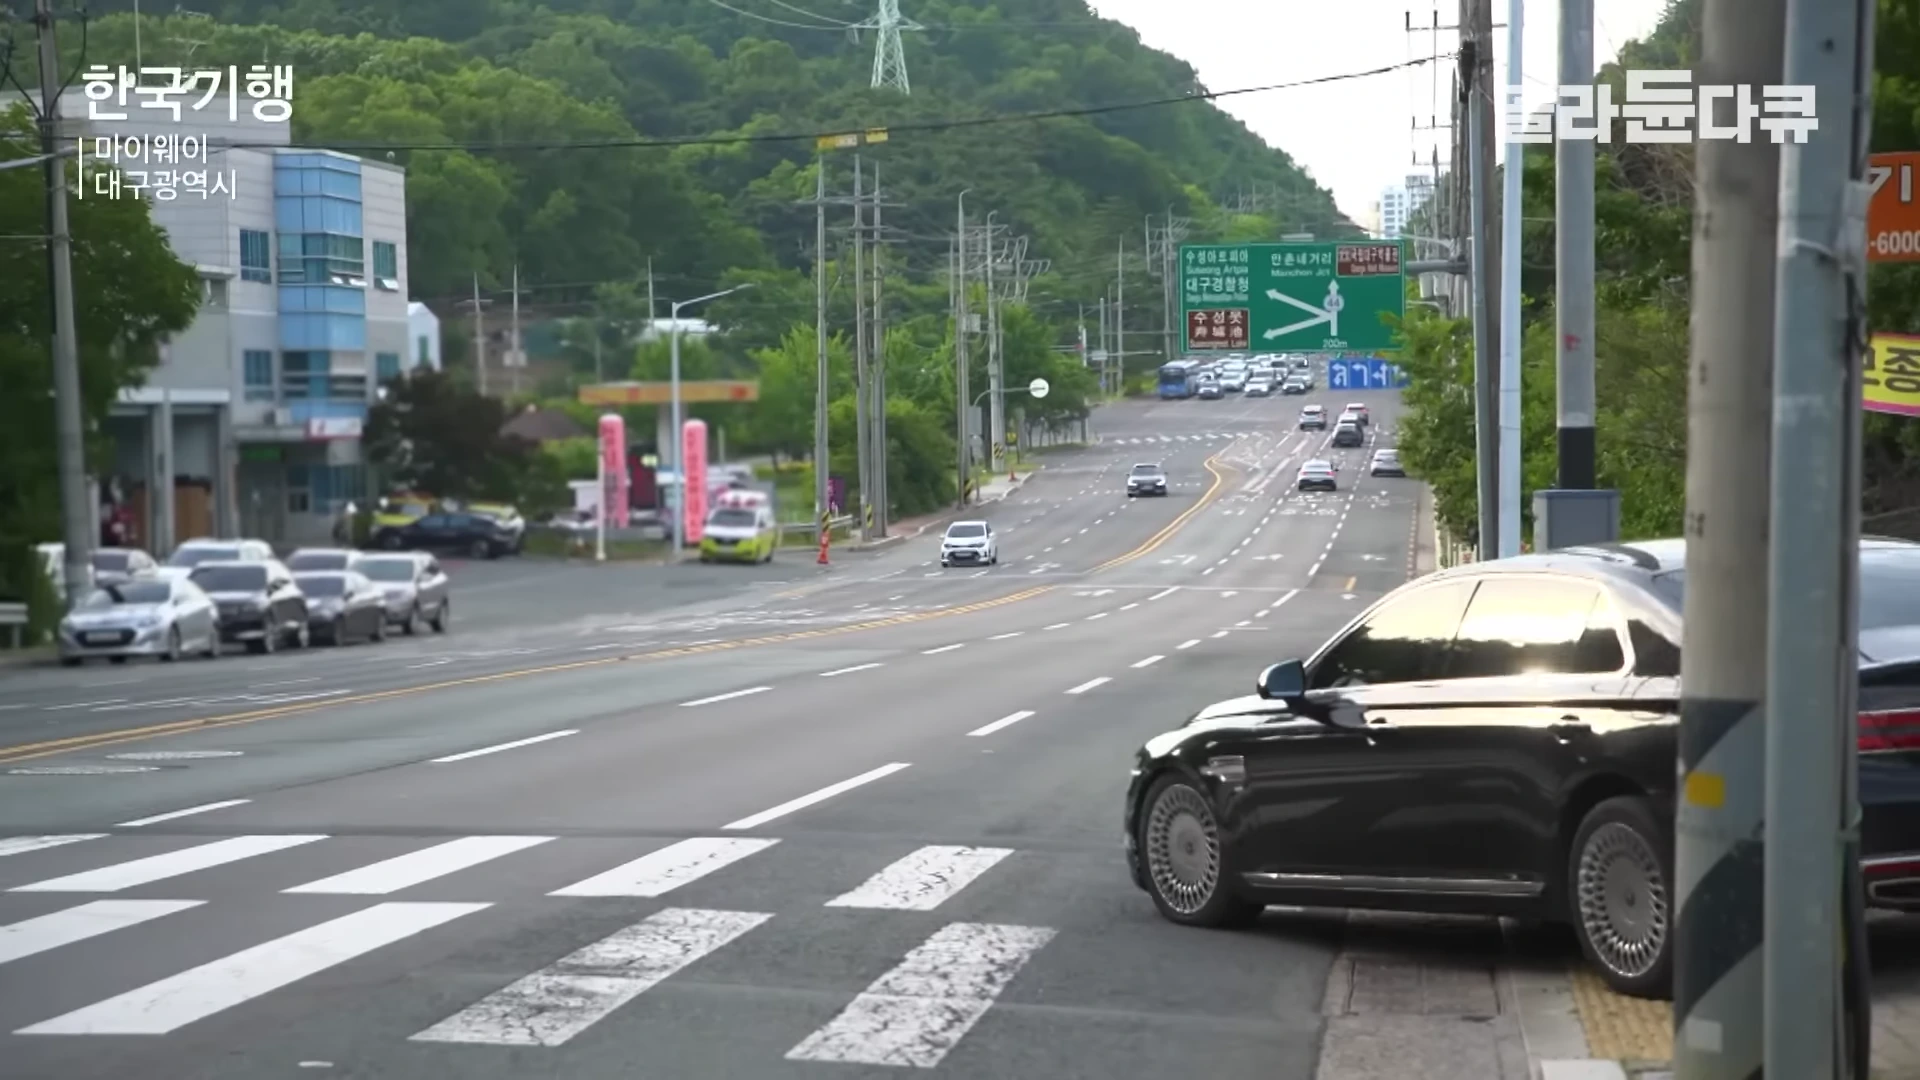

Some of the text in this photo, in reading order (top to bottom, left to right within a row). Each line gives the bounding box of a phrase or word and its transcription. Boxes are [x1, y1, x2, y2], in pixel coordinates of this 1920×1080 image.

[1866, 231, 1920, 254] -6000
[1186, 248, 1248, 264] 수성아트피아
[1271, 252, 1332, 266] 만촌네거리
[1186, 276, 1248, 292] 대구경찰청
[1322, 338, 1348, 348] 200m
